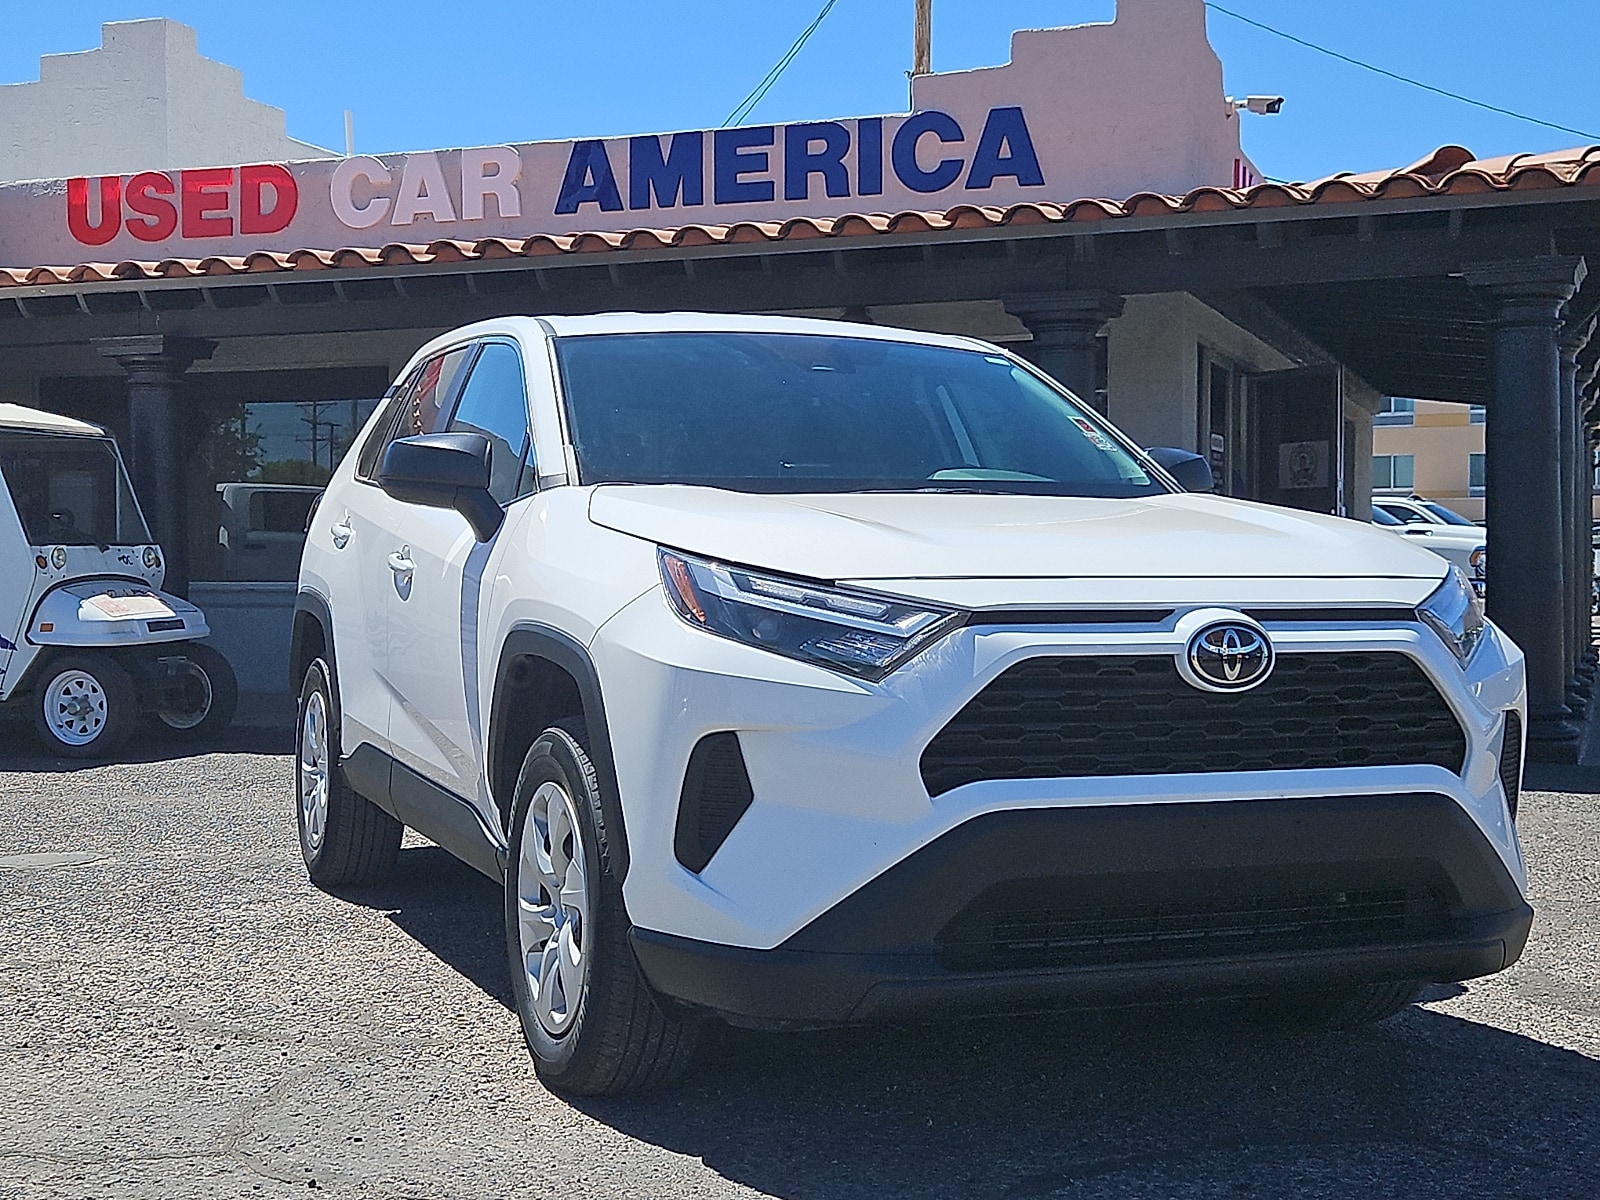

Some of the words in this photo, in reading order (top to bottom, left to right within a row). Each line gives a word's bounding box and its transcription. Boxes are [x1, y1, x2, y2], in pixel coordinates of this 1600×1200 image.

[67, 164, 298, 246] USED
[330, 145, 522, 229] CAR
[554, 106, 1045, 214] AMERICA
